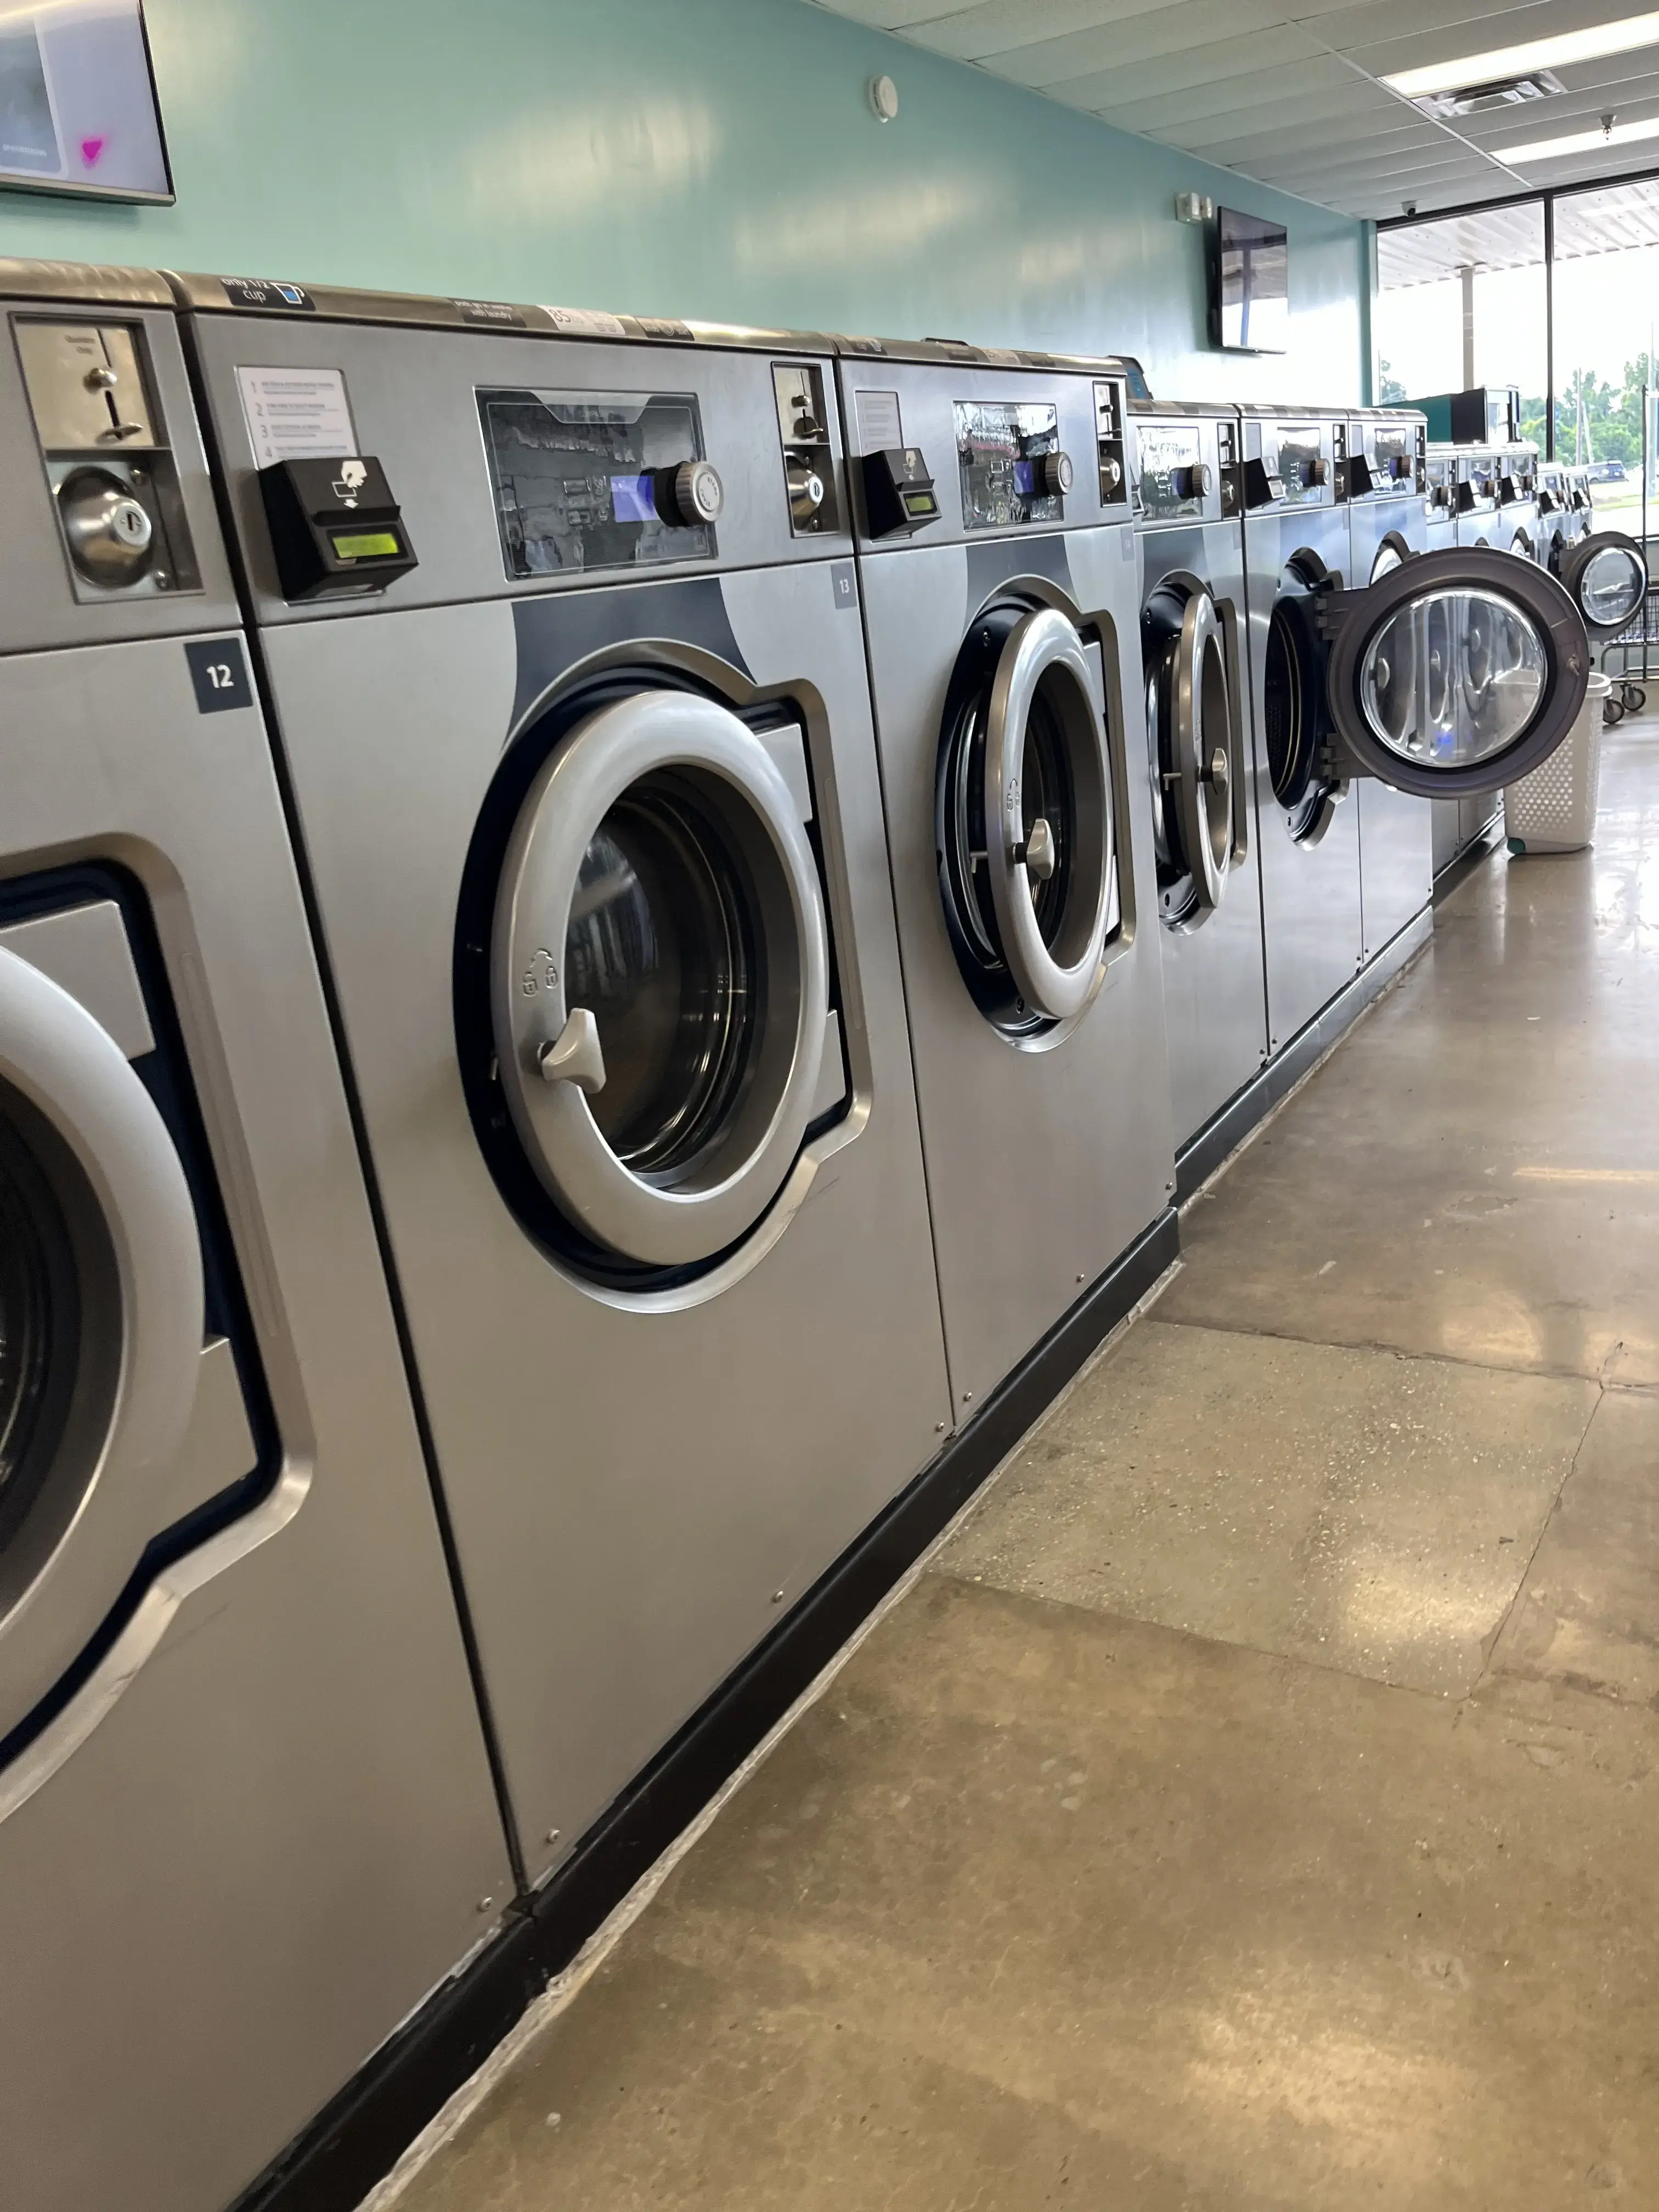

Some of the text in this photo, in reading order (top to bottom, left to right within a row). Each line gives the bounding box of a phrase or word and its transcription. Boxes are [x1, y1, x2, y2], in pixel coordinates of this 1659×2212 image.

[221, 278, 270, 290] only 1/2
[242, 290, 266, 304] cup
[549, 309, 571, 323] 85
[256, 402, 264, 416] 2
[260, 425, 268, 438] 3
[839, 579, 849, 594] 13
[206, 664, 234, 688] 12
